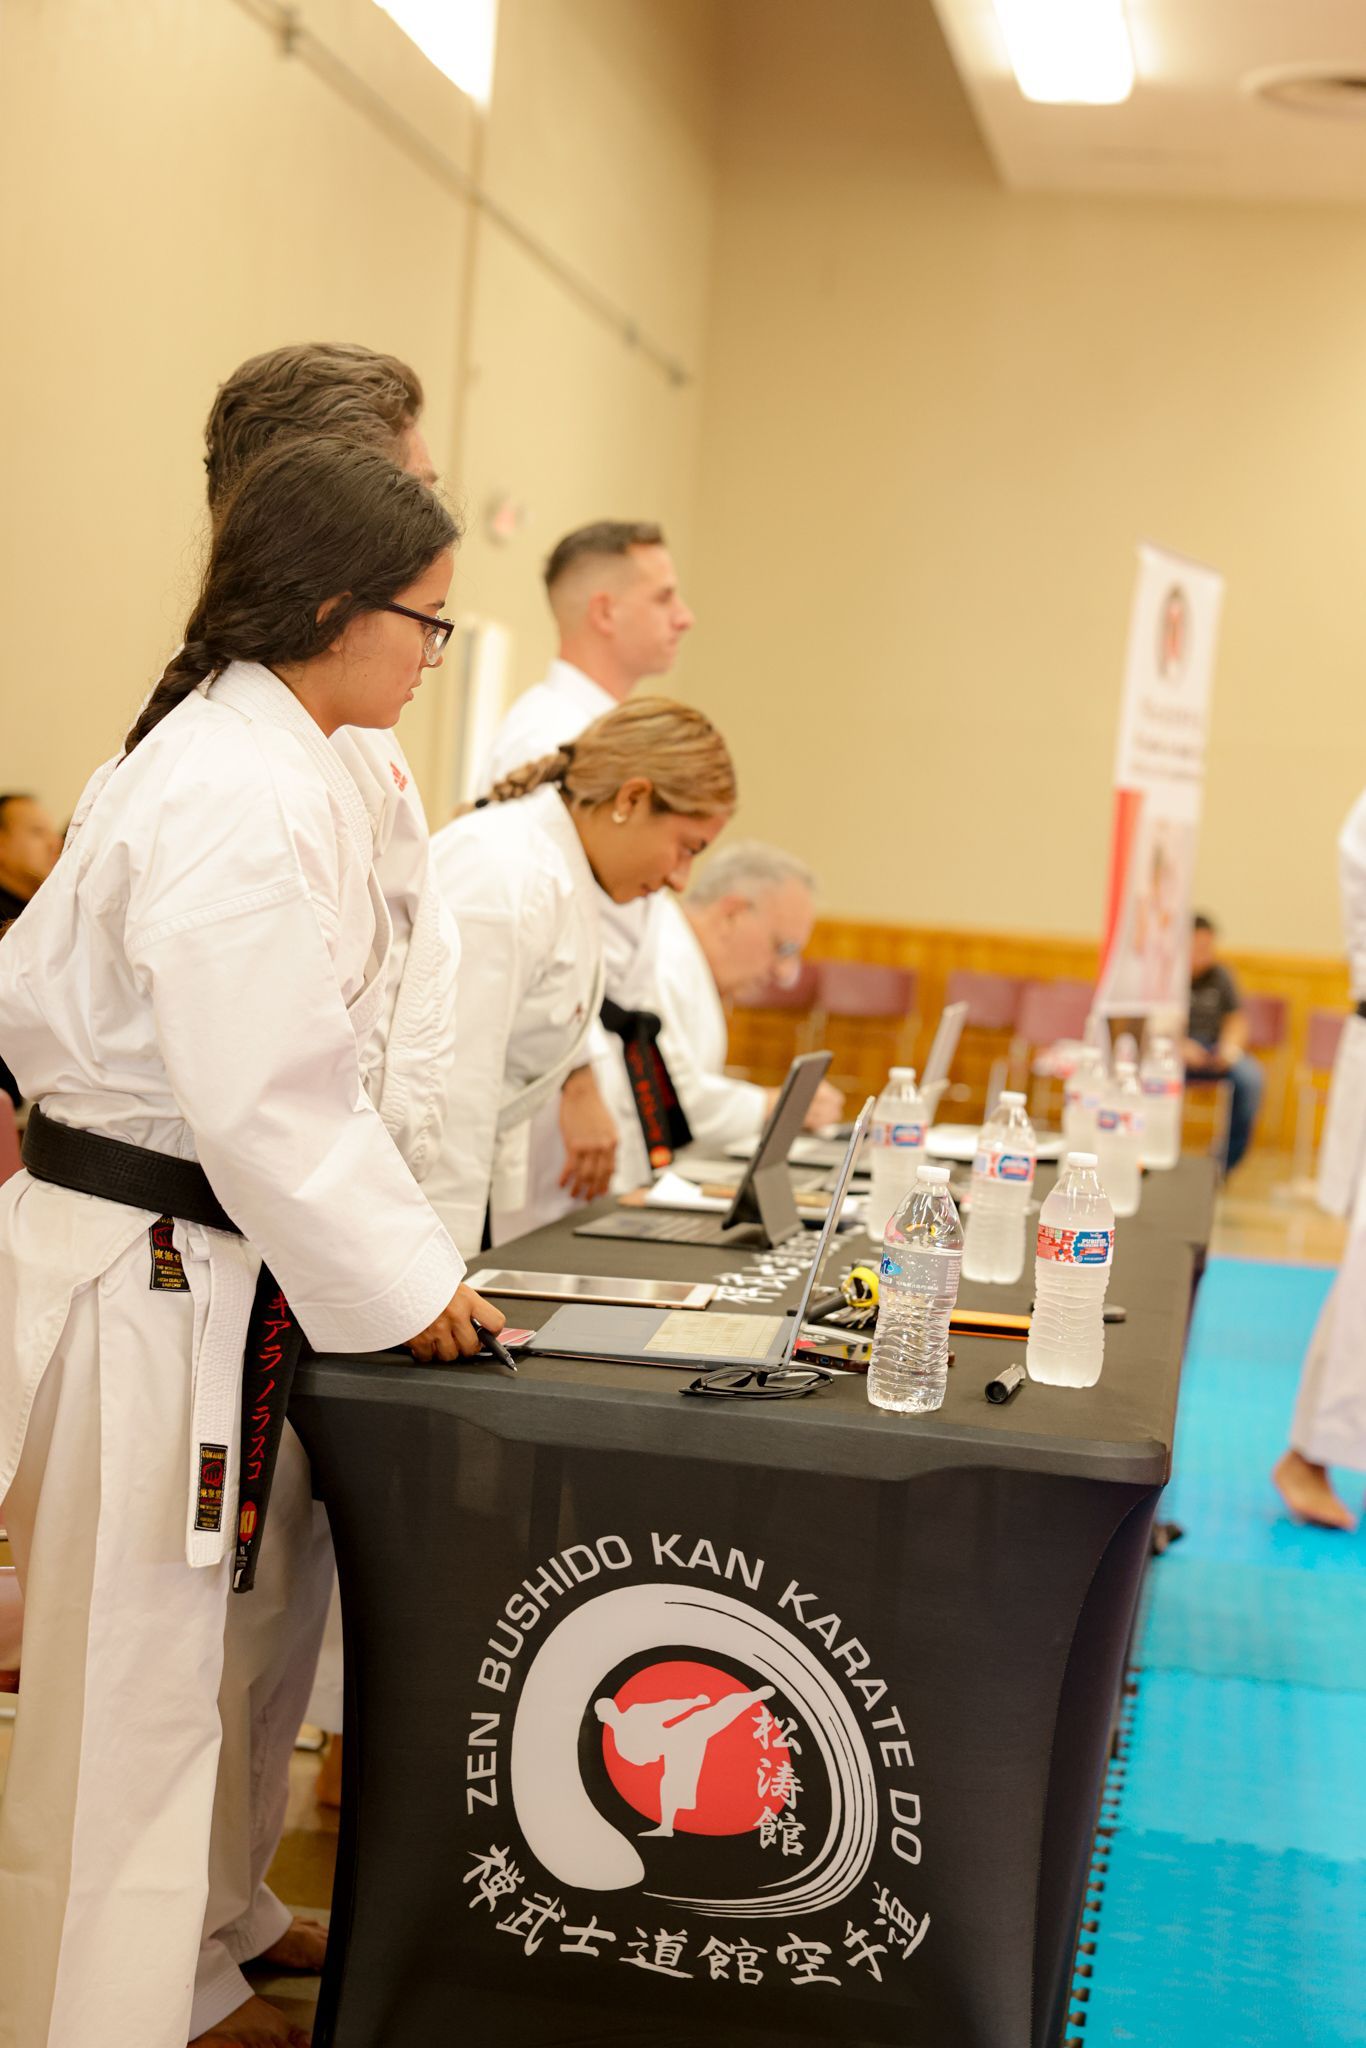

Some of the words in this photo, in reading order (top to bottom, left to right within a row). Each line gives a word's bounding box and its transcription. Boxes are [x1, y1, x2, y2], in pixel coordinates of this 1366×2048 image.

[650, 1532, 765, 1591] KAN
[477, 1535, 633, 1693] BUSHIDO
[777, 1579, 915, 1768] KARATE
[466, 1712, 501, 1815] ZEN
[889, 1788, 922, 1865] DO
